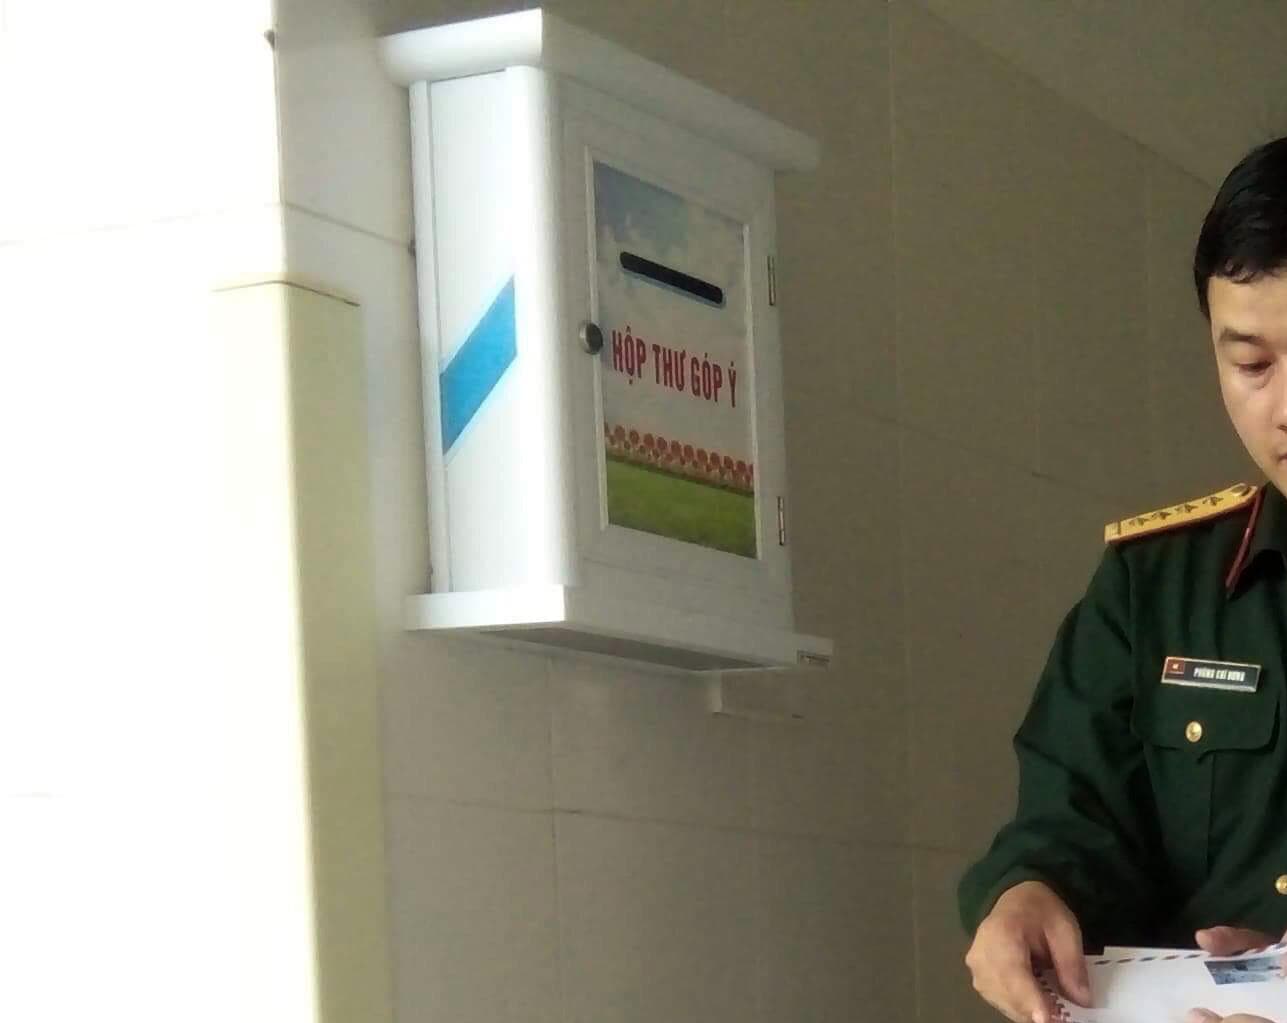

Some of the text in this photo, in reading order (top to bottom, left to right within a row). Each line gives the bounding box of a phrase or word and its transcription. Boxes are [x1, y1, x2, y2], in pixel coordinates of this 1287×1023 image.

[612, 326, 737, 408] HỘP THƯ GÓP Ý
